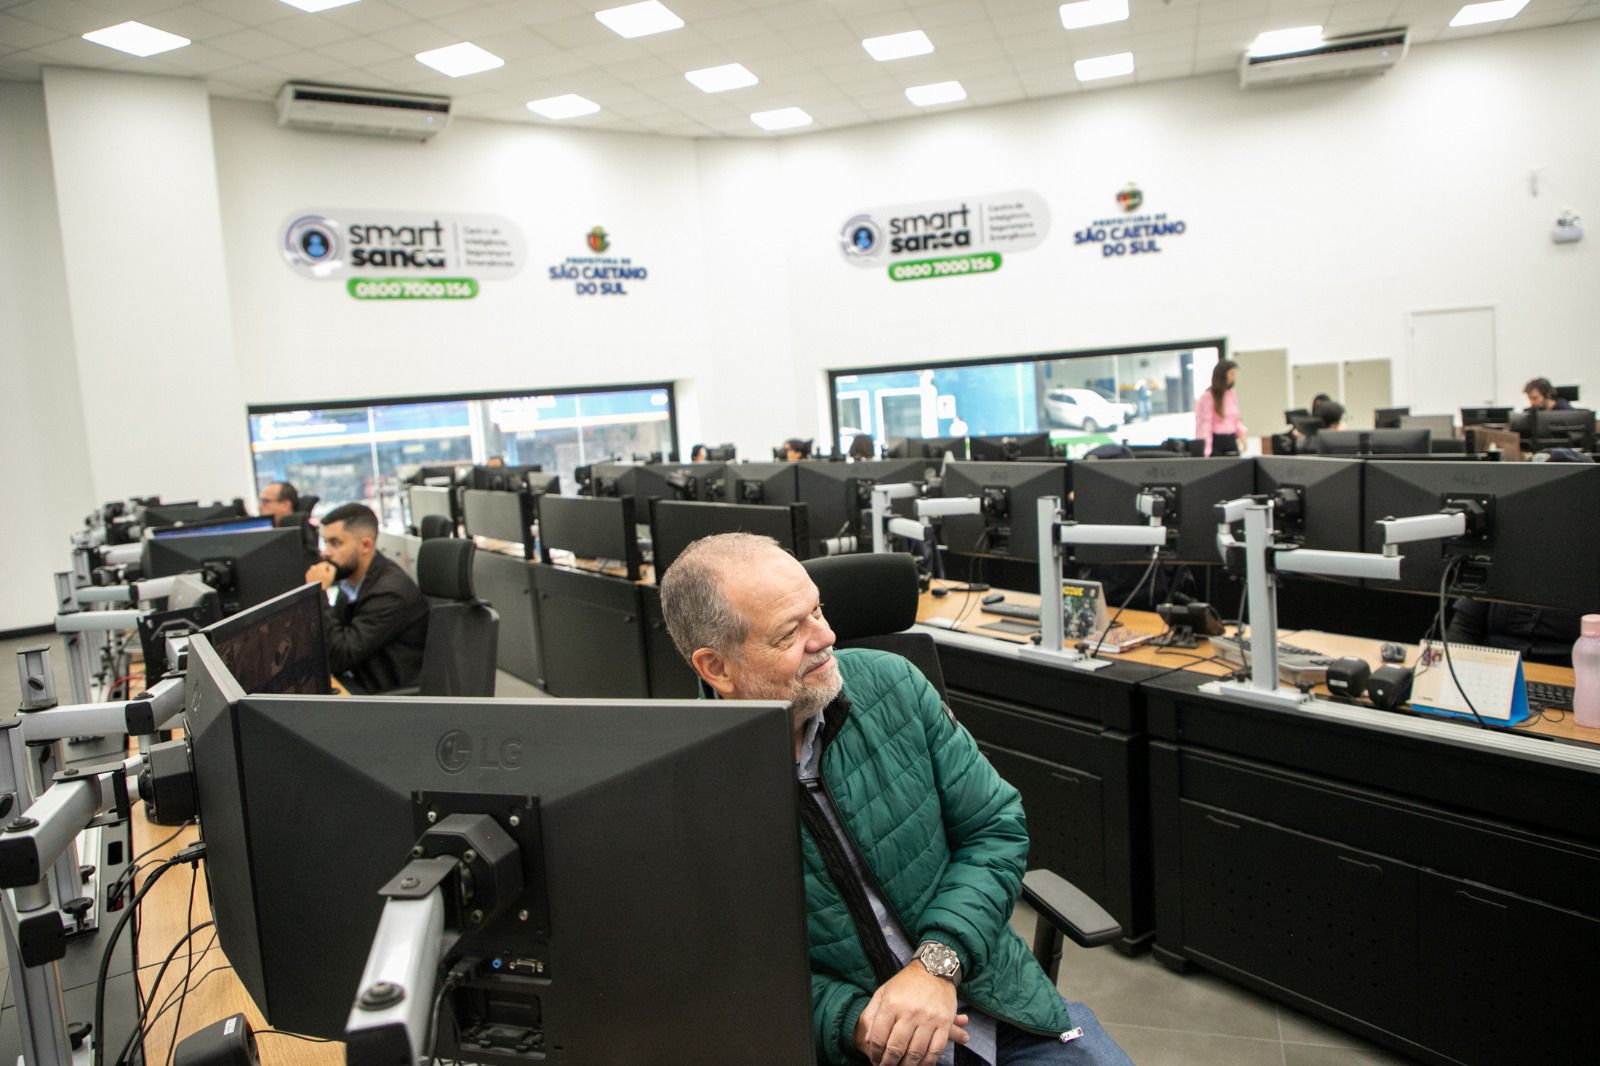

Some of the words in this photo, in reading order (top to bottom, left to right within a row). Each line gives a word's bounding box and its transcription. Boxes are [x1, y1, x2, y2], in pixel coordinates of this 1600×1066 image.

[889, 202, 970, 235] smart
[349, 219, 444, 247] smart
[890, 230, 971, 254] sanca
[1074, 227, 1106, 245] SÃO
[1110, 220, 1187, 241] CAETANO
[351, 248, 446, 268] sanca
[1103, 241, 1126, 257] DO
[1129, 239, 1162, 255] SUL
[549, 263, 579, 280] SÃO
[582, 265, 648, 280] CAETANO
[894, 262, 932, 279] 0800
[932, 258, 970, 275] 7000
[970, 255, 994, 271] 156
[355, 281, 401, 298] 0800
[401, 282, 445, 298] 7000
[446, 281, 472, 297] 156
[576, 281, 598, 295] DO
[600, 281, 628, 295] SUL
[479, 737, 523, 771] LG
